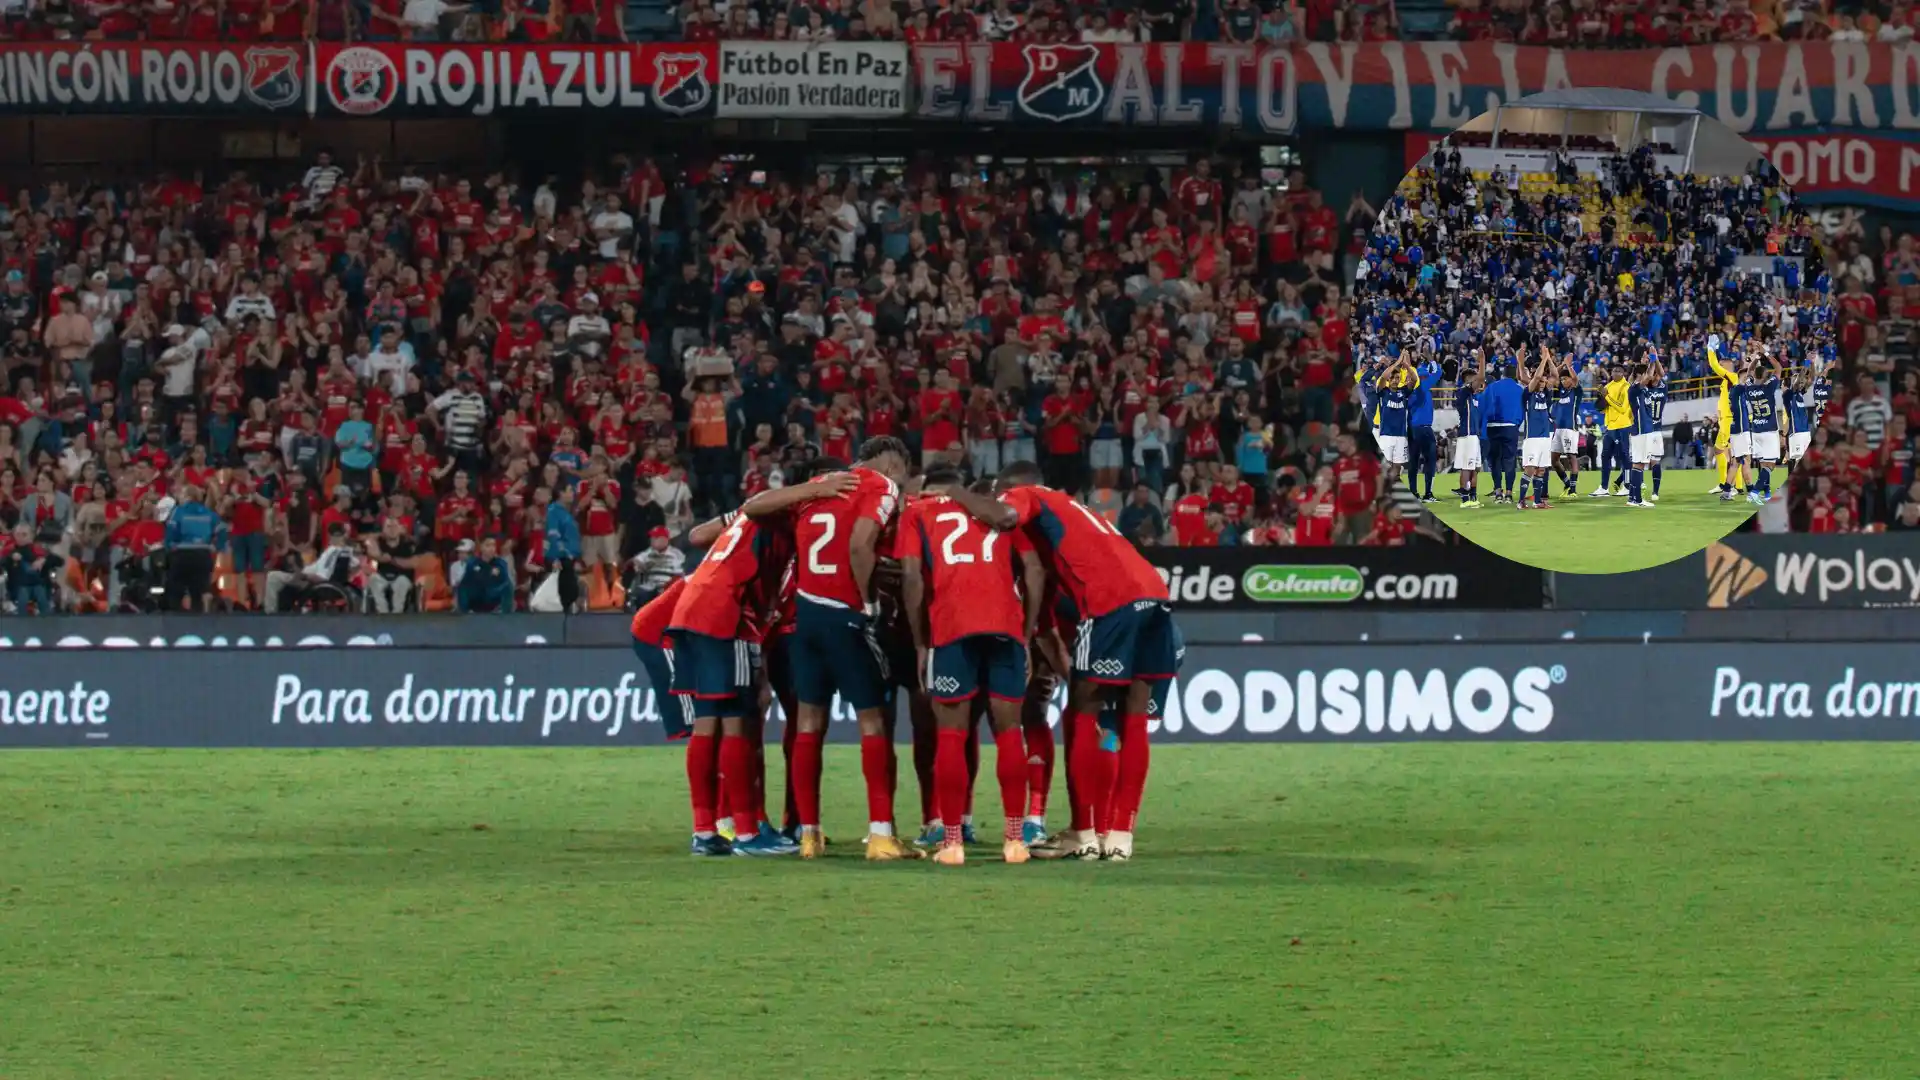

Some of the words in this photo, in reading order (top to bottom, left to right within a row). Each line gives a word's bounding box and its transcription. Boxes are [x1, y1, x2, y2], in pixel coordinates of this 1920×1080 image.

[142, 48, 242, 103] ROJO
[405, 48, 646, 115] ROJIAZUL
[723, 50, 809, 75] Fútbol
[817, 52, 848, 75] En
[855, 52, 902, 77] Paz
[914, 42, 1013, 119] EL
[1103, 42, 1299, 135] ALTO
[723, 82, 790, 105] Pasión
[797, 83, 900, 108] Verdadera
[1751, 139, 1876, 185] OMO
[808, 513, 837, 575] 2
[1155, 565, 1236, 602] ide
[1246, 571, 1359, 593] Colanta
[1364, 573, 1458, 600] .com
[272, 673, 372, 724] Para
[384, 673, 535, 723] dormir
[541, 672, 662, 736] profu
[1710, 666, 1813, 718] Para
